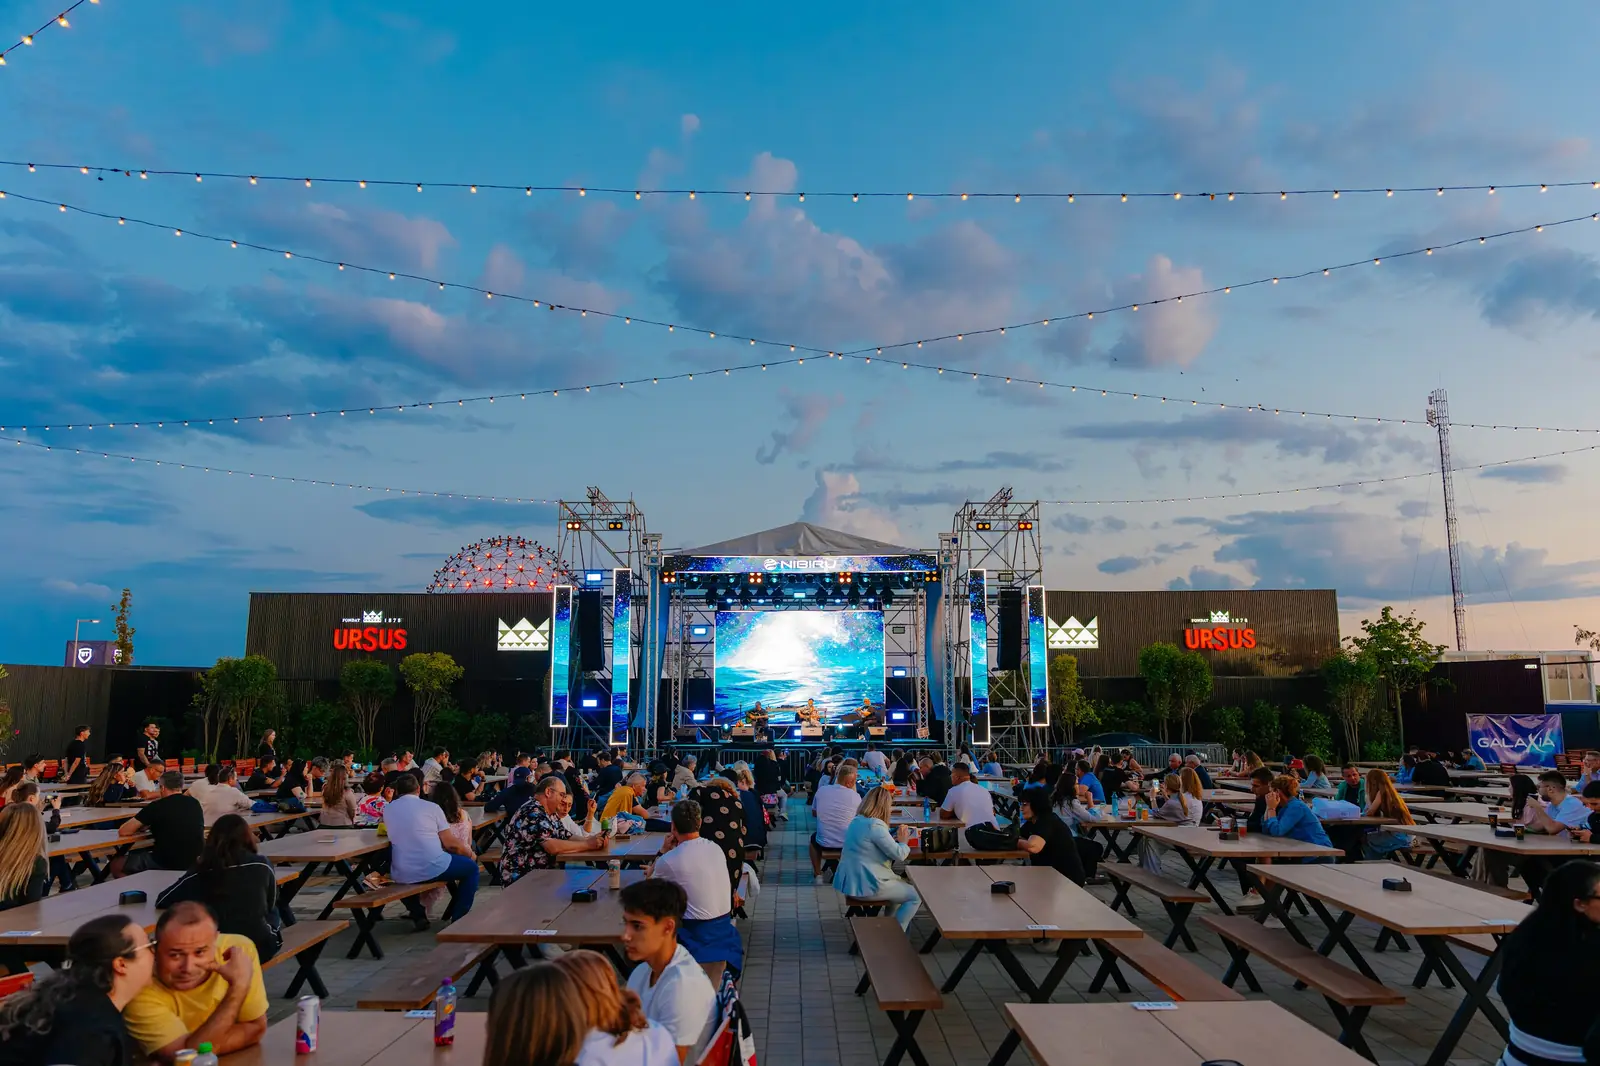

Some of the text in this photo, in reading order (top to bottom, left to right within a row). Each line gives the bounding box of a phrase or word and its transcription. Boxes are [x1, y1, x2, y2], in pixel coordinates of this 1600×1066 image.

[780, 559, 837, 569] NIBIRU
[333, 625, 408, 652] URSUS
[1184, 625, 1257, 652] URSUS
[1477, 728, 1556, 754] GALAXIA
